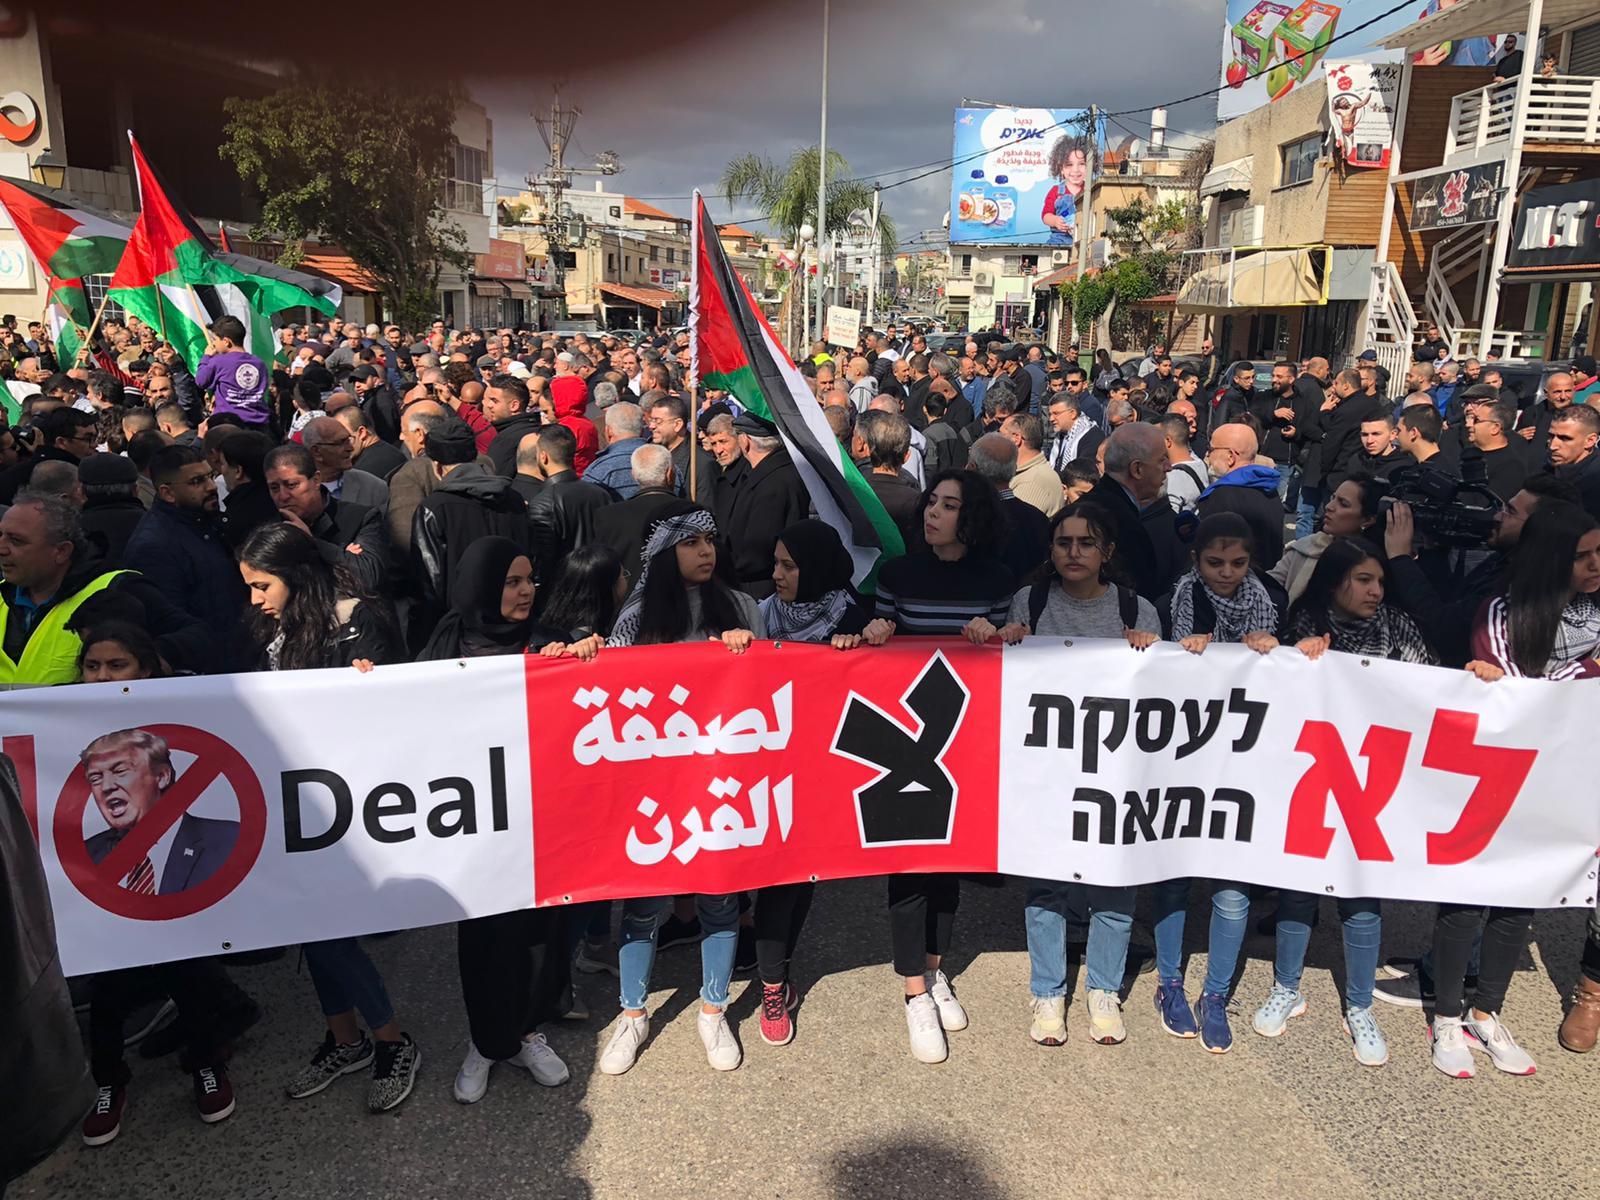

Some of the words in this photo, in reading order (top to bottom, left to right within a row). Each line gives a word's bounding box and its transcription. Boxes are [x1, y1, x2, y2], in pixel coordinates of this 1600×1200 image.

[1369, 67, 1398, 79] MAX
[573, 680, 793, 766] لصفقة
[829, 648, 971, 849] لا
[1023, 687, 1270, 774] לעסקת
[280, 746, 509, 854] Deal
[625, 774, 793, 866] القرن
[1072, 786, 1256, 846] המאה
[1284, 707, 1539, 866] לא
